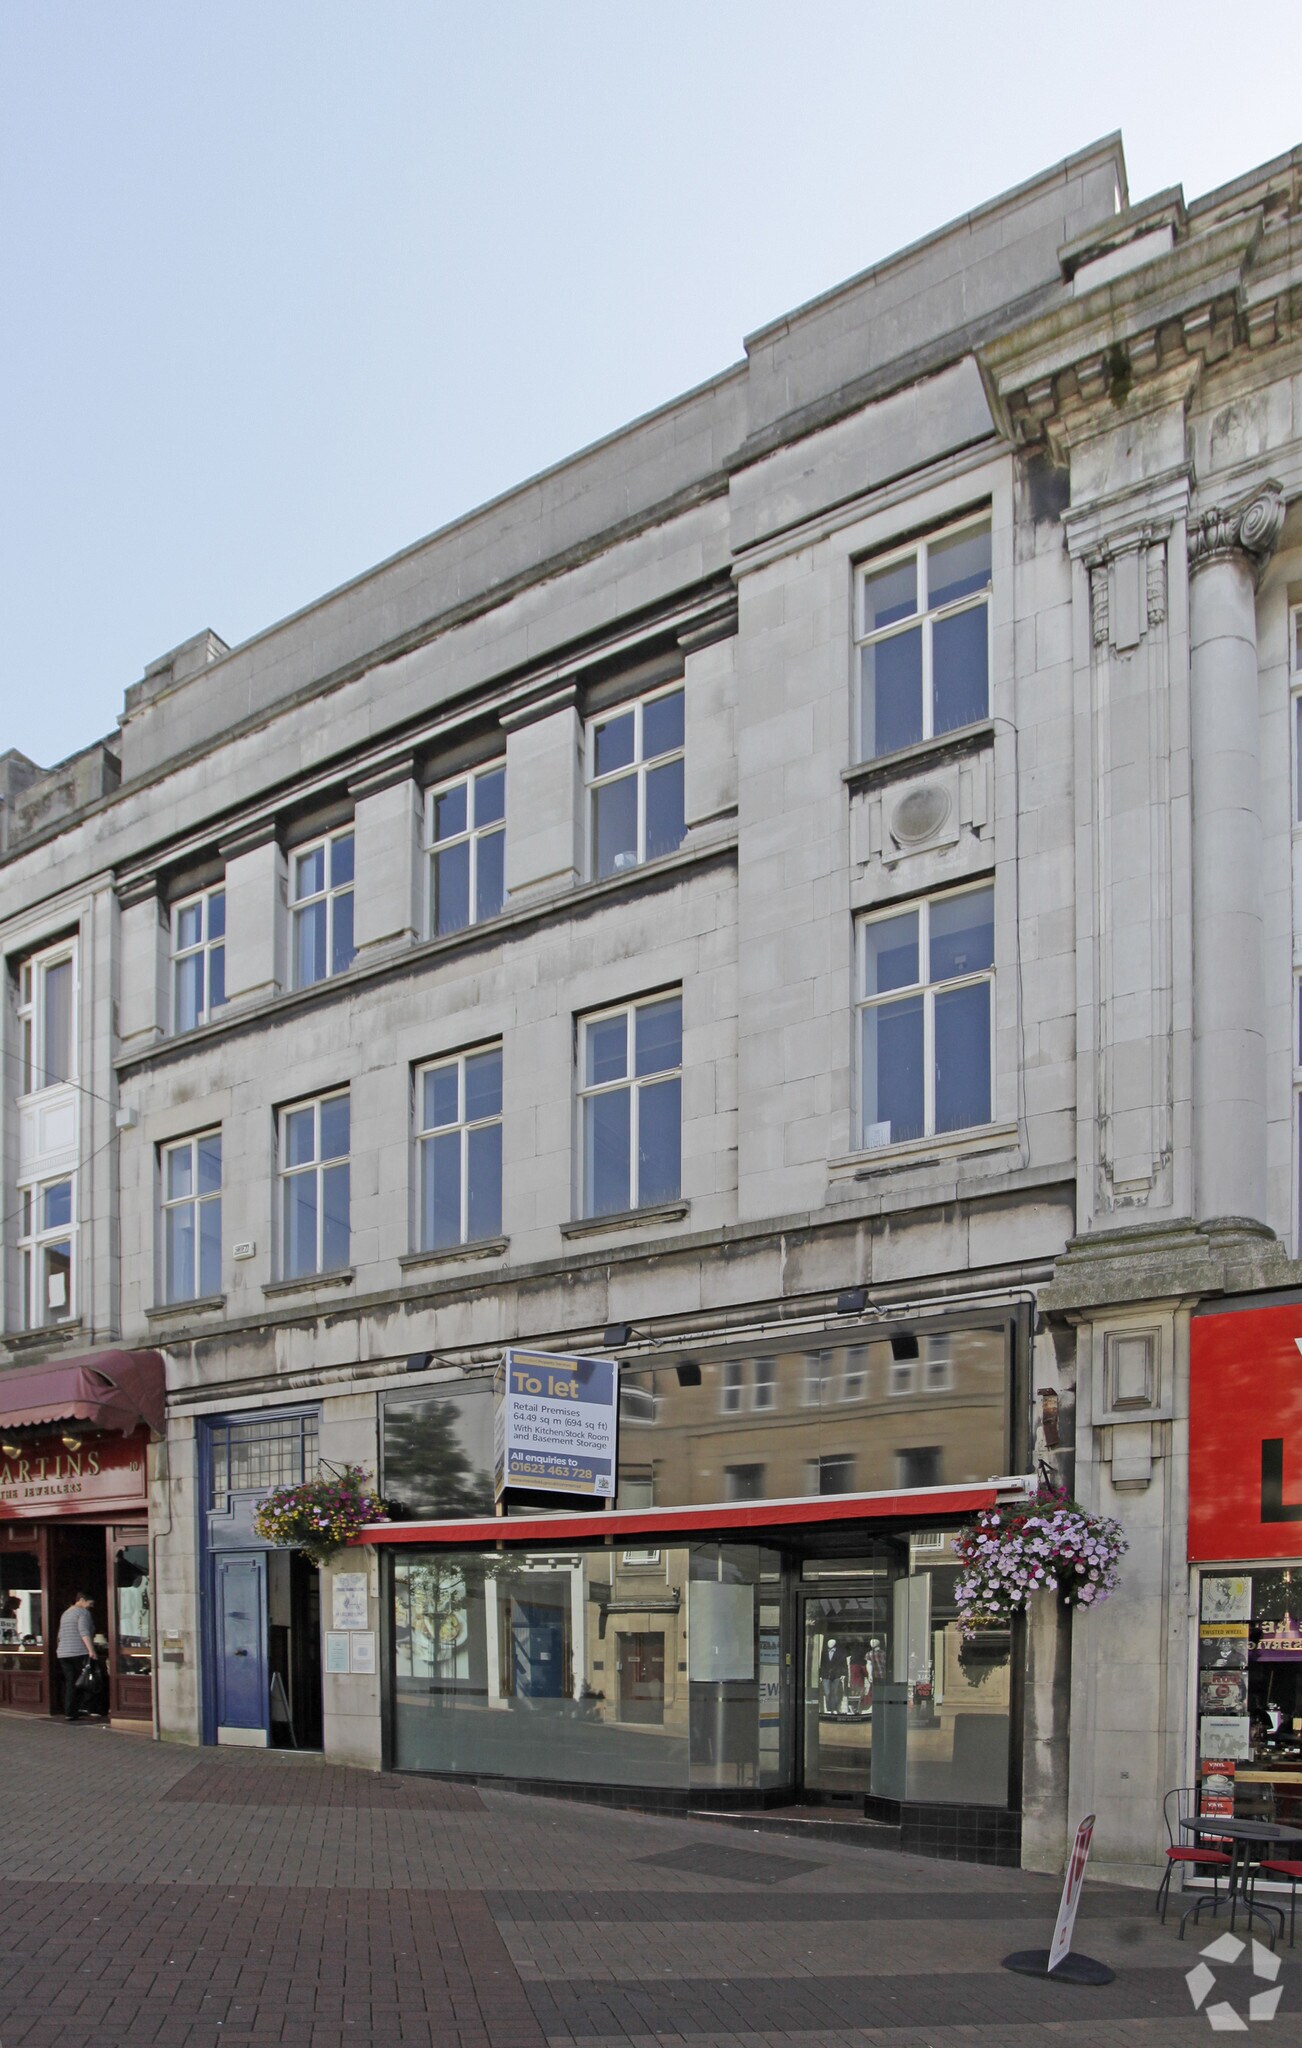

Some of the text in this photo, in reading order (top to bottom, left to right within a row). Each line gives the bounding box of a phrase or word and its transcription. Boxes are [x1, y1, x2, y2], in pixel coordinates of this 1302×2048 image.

[513, 1371, 579, 1399] To let
[513, 1402, 580, 1417] Retail Premises
[513, 1412, 537, 1422] 64.49
[540, 1417, 550, 1425] sq
[564, 1418, 582, 1427] (694
[585, 1422, 595, 1430] sq
[597, 1421, 608, 1431] ft)
[513, 1424, 610, 1441] With Kitchen/Stock Room
[513, 1432, 607, 1450] and Basement Storage
[130, 1461, 140, 1472] 10
[511, 1451, 578, 1467] All enquiries to
[511, 1461, 593, 1479] 01623 463 728
[0, 1483, 82, 1500] THE JEWELLERS
